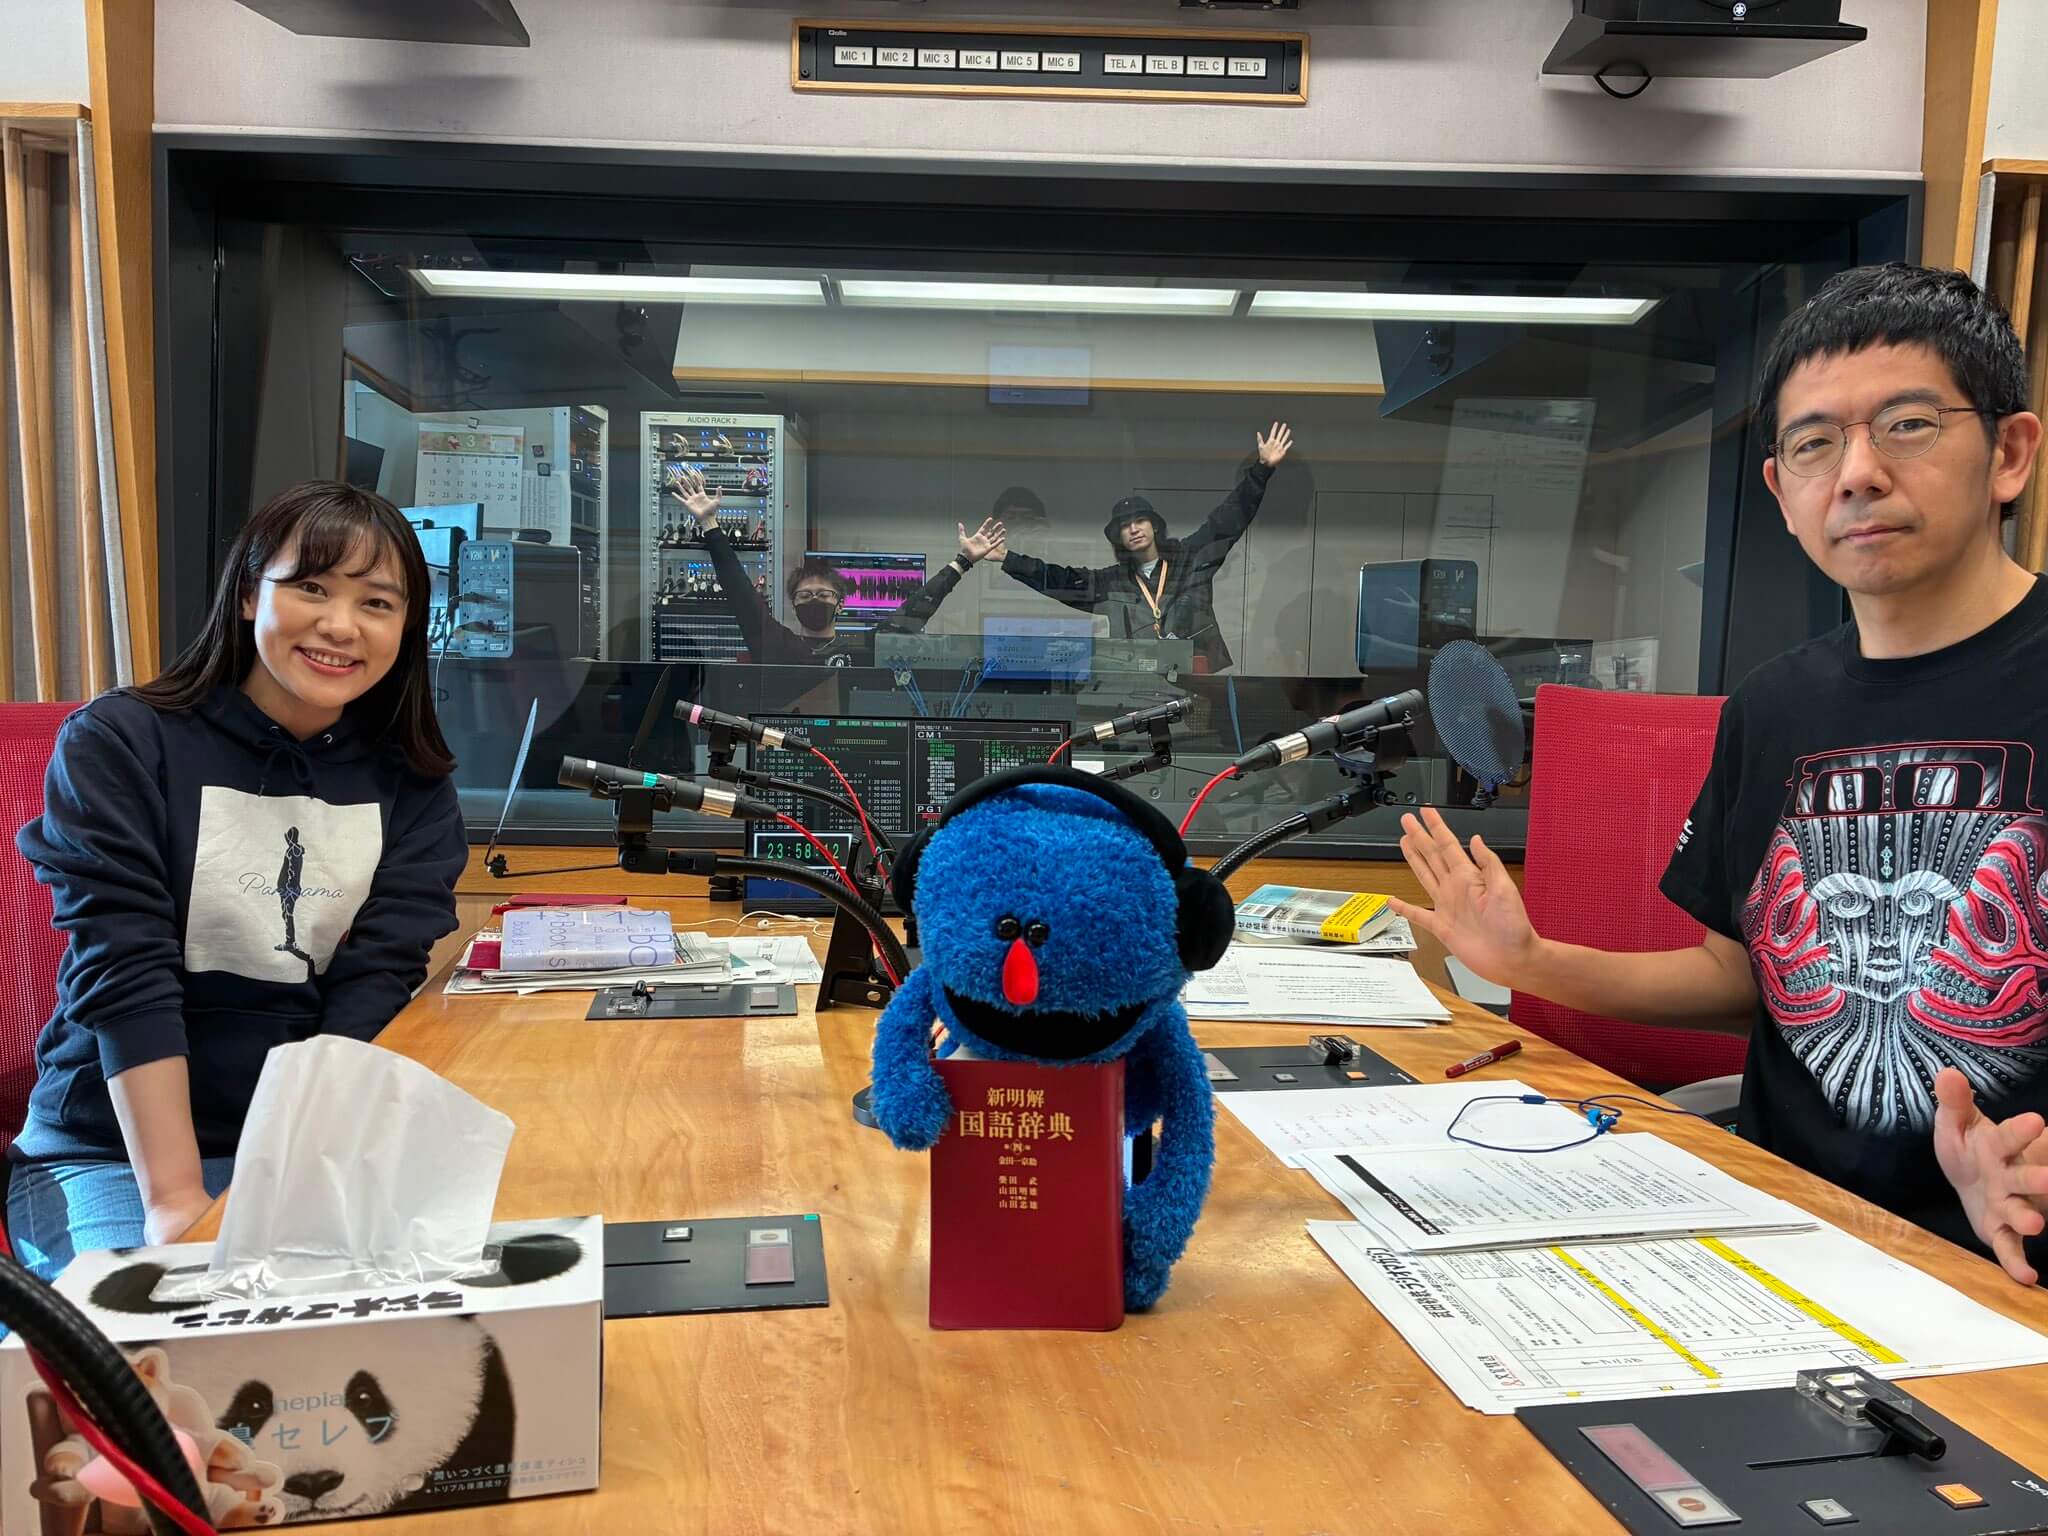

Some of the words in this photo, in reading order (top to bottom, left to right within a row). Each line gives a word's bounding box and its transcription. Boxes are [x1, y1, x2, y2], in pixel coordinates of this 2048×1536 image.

[840, 50, 857, 60] MIC
[862, 50, 867, 61] 1
[882, 51, 898, 61] MIC
[902, 51, 908, 62] 2
[924, 53, 940, 63] MIC
[943, 53, 950, 64] 3
[965, 55, 982, 64] MIC
[985, 55, 991, 65] 4
[1006, 55, 1023, 65] MIC
[1026, 55, 1033, 66] 5
[1047, 57, 1064, 66] MIC
[1067, 57, 1074, 67] 6
[1110, 58, 1127, 68] TEL
[1129, 58, 1136, 69] A
[1151, 60, 1168, 69] TEL
[1171, 60, 1178, 70] B
[1192, 61, 1209, 70] TEL
[1212, 61, 1219, 71] C
[1233, 62, 1250, 71] TEL
[1253, 62, 1260, 72] D
[687, 416, 710, 424] AUDIO
[711, 416, 730, 424] RACK
[466, 434, 476, 448] 3
[794, 727, 808, 735] PG1
[917, 805, 942, 813] PG1
[986, 1087, 1045, 1108] 新明解
[960, 1110, 1075, 1141] 国語辞典
[274, 1391, 346, 1412] nepia
